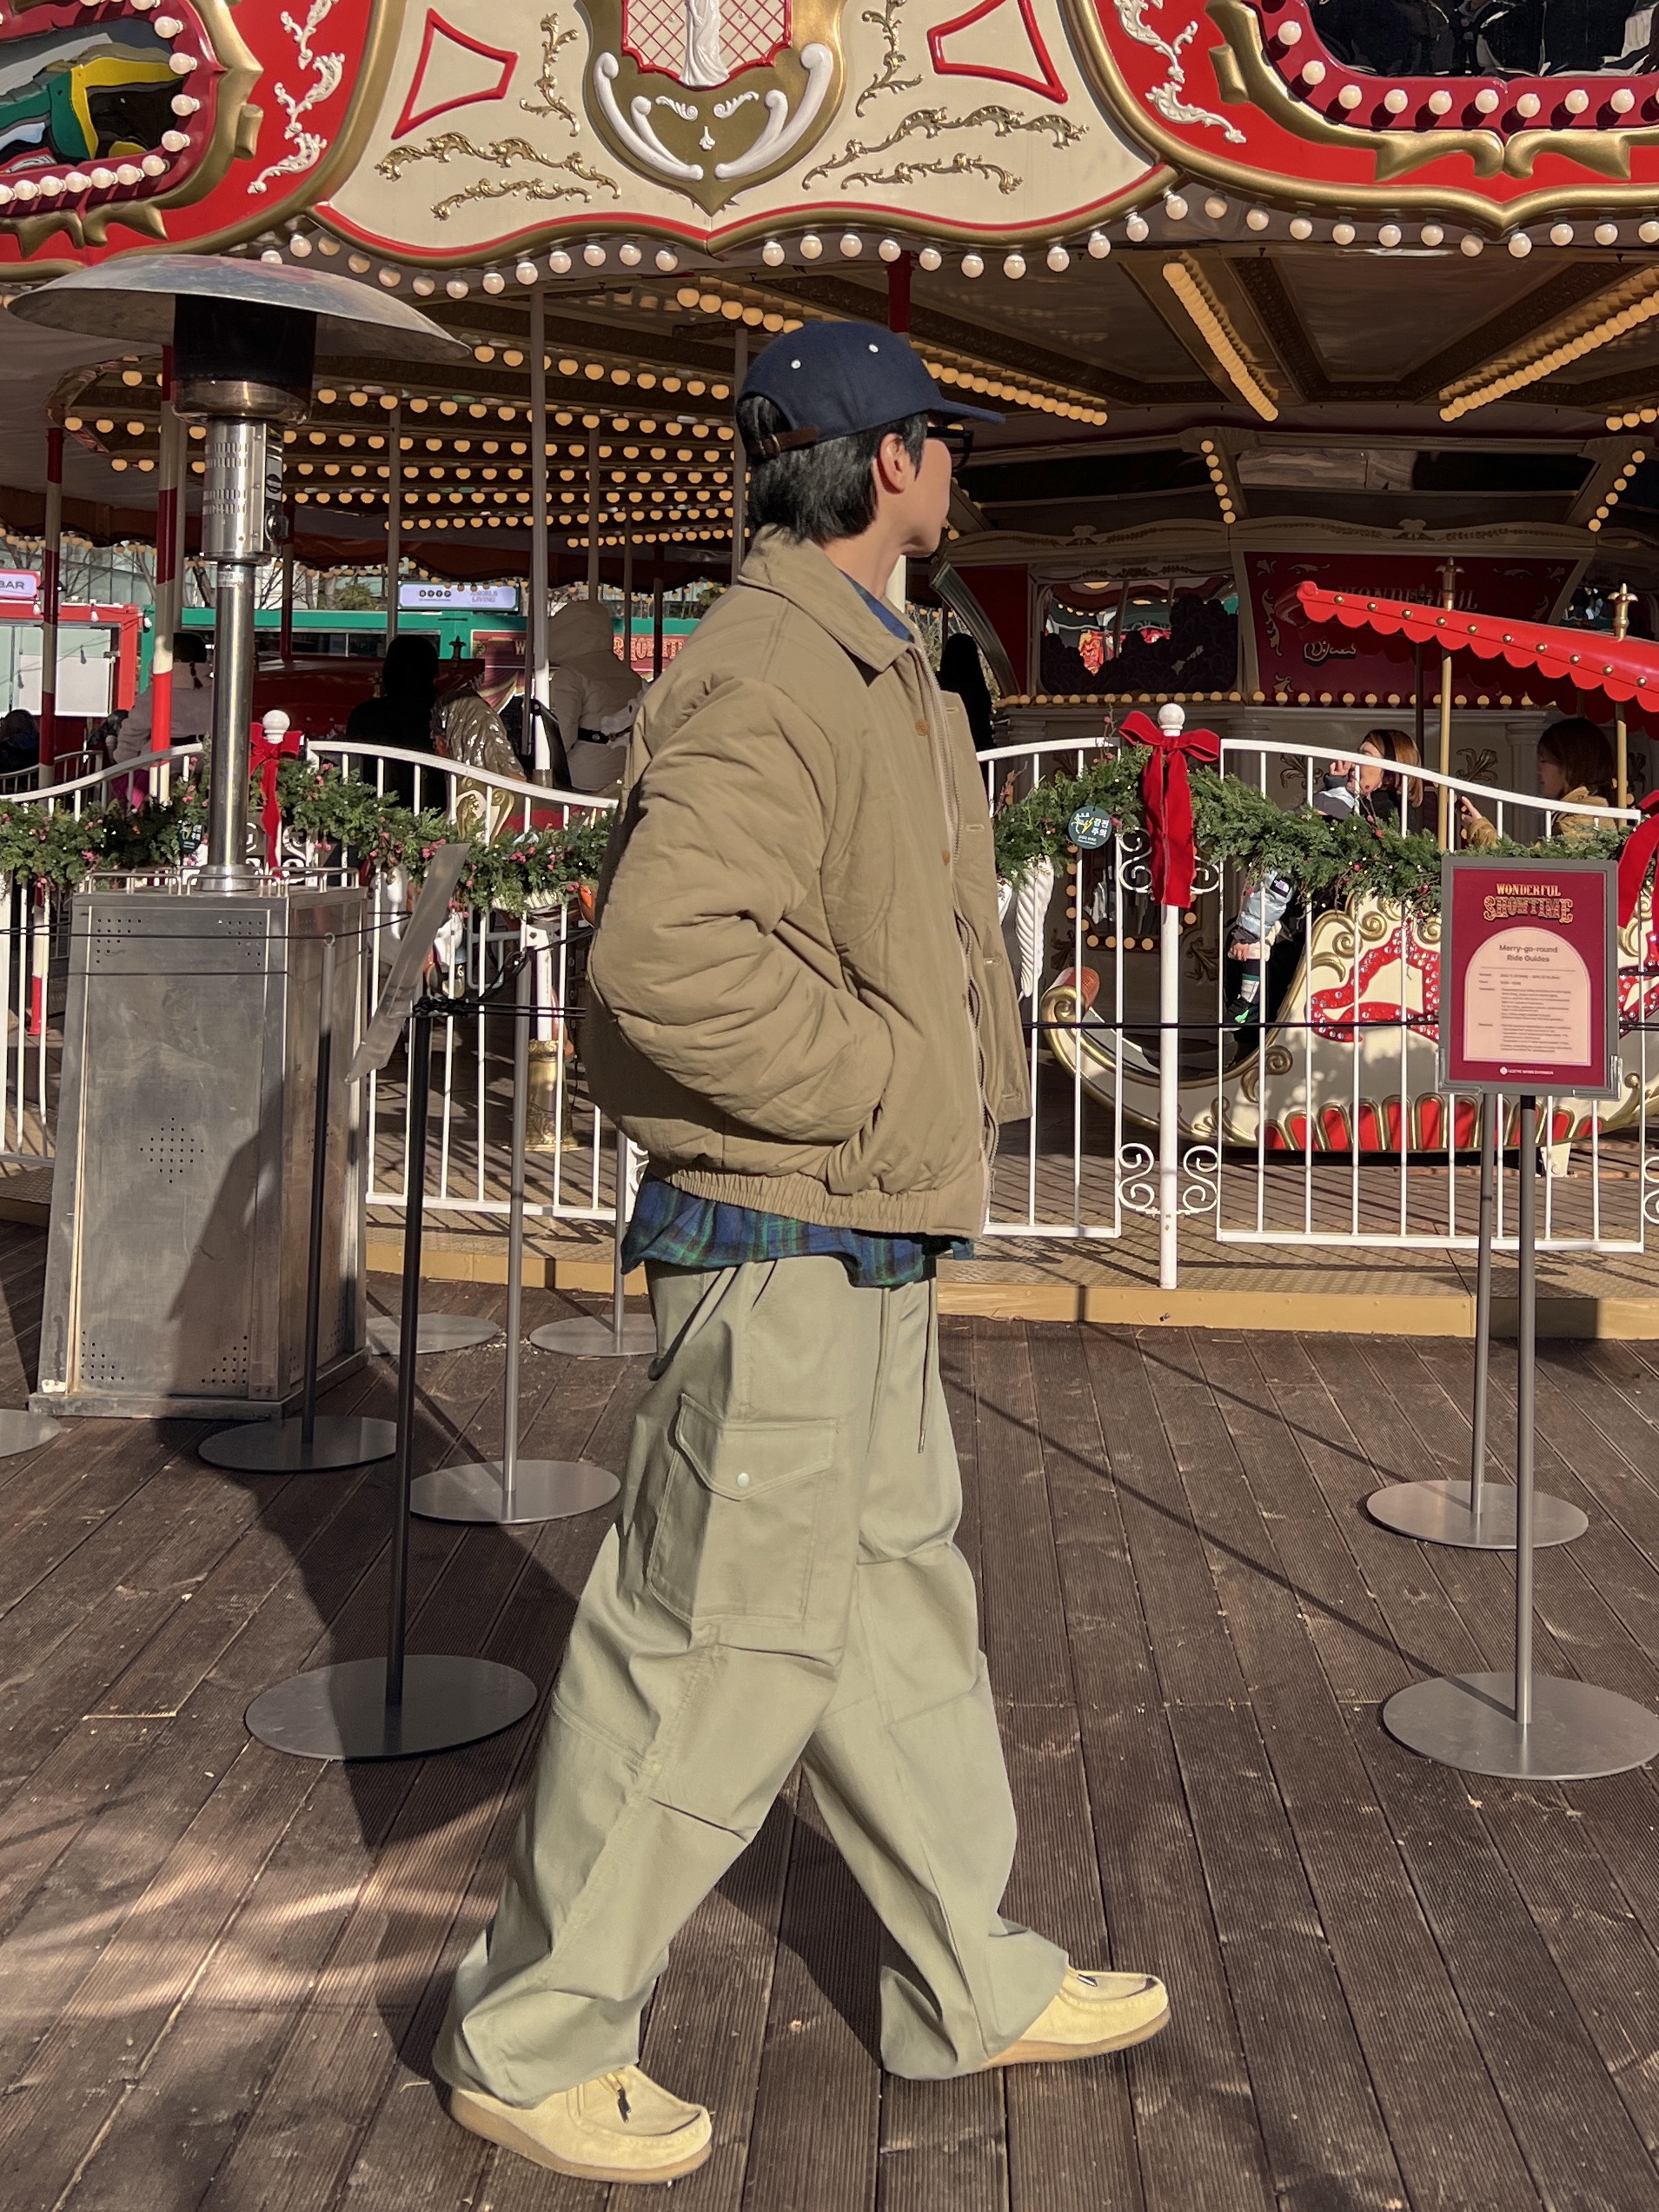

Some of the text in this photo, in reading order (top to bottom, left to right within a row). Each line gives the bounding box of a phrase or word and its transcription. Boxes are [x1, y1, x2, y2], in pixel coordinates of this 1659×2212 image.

[1496, 883, 1562, 896] WONDERFUL
[1483, 895, 1574, 923] SHOWTIME
[1499, 945, 1558, 953] Merry-go-round
